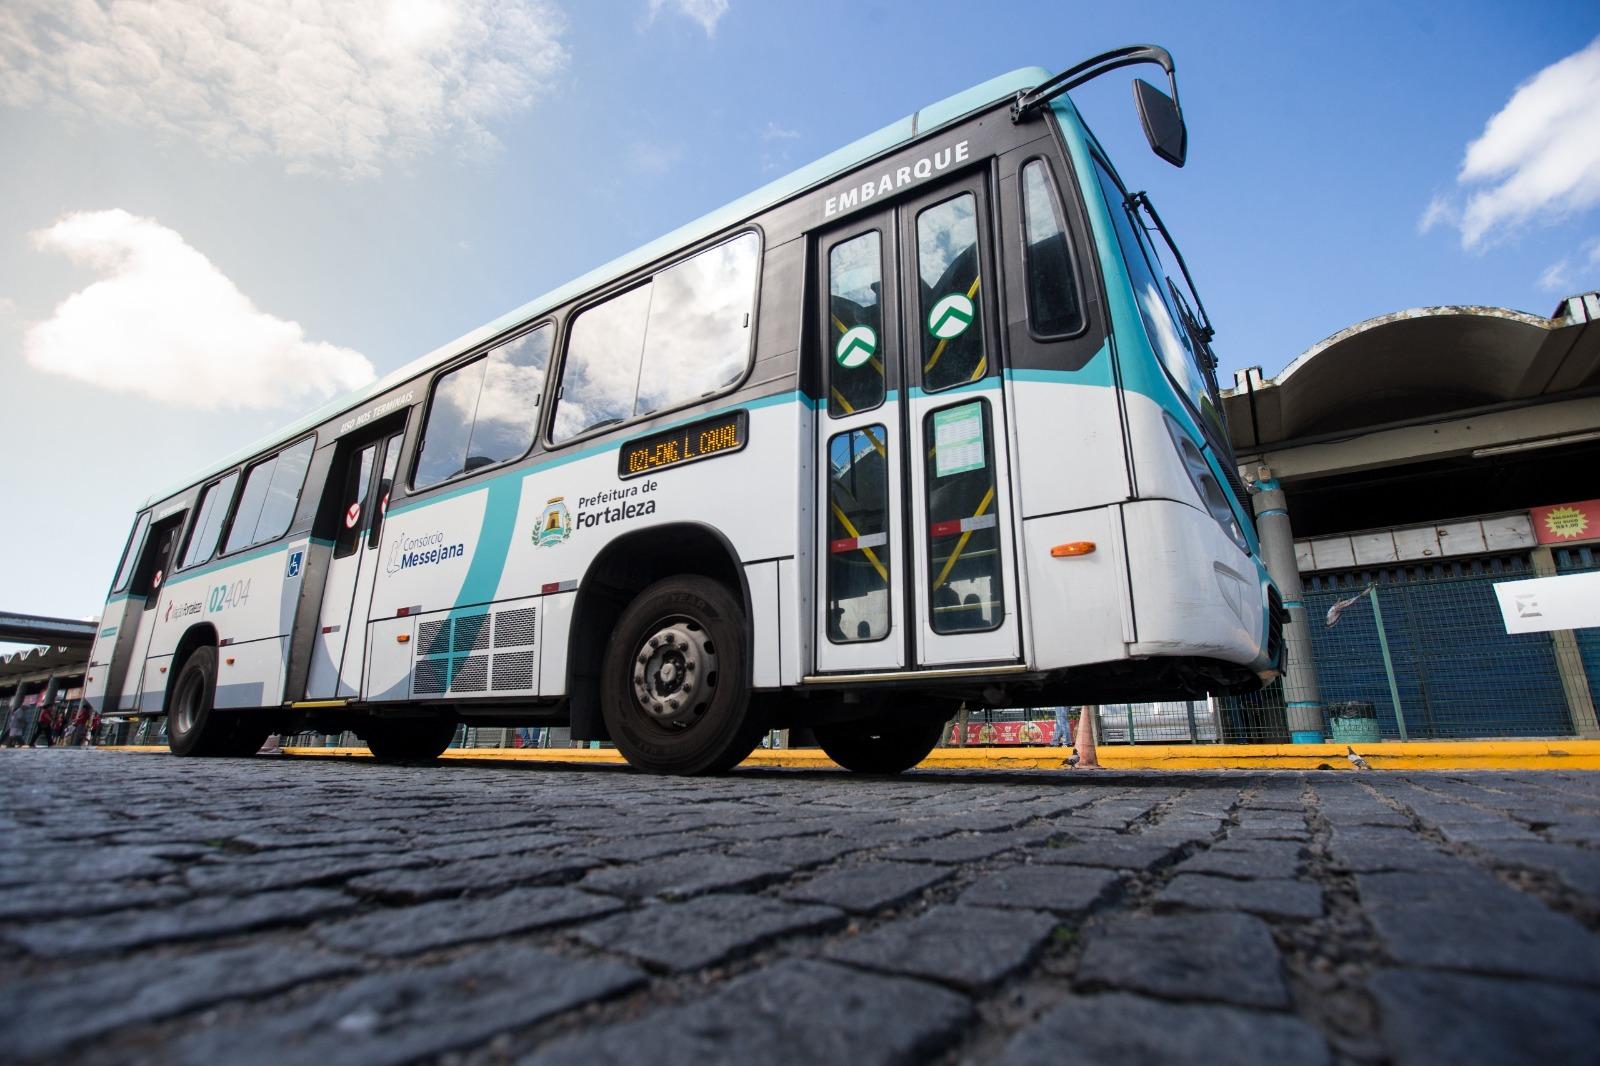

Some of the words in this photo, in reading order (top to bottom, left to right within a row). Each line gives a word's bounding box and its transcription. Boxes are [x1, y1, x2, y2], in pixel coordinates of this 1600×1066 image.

[825, 140, 969, 217] EMBARQUE
[340, 418, 356, 433] USO
[356, 410, 372, 426] NOS
[373, 390, 414, 418] TERMINAIS
[700, 424, 739, 453] CAVAL
[578, 486, 638, 509] Prefeitura
[642, 480, 658, 493] de
[576, 500, 656, 530] Fortaleza
[401, 543, 464, 569] Messejana
[208, 577, 251, 613] 02404
